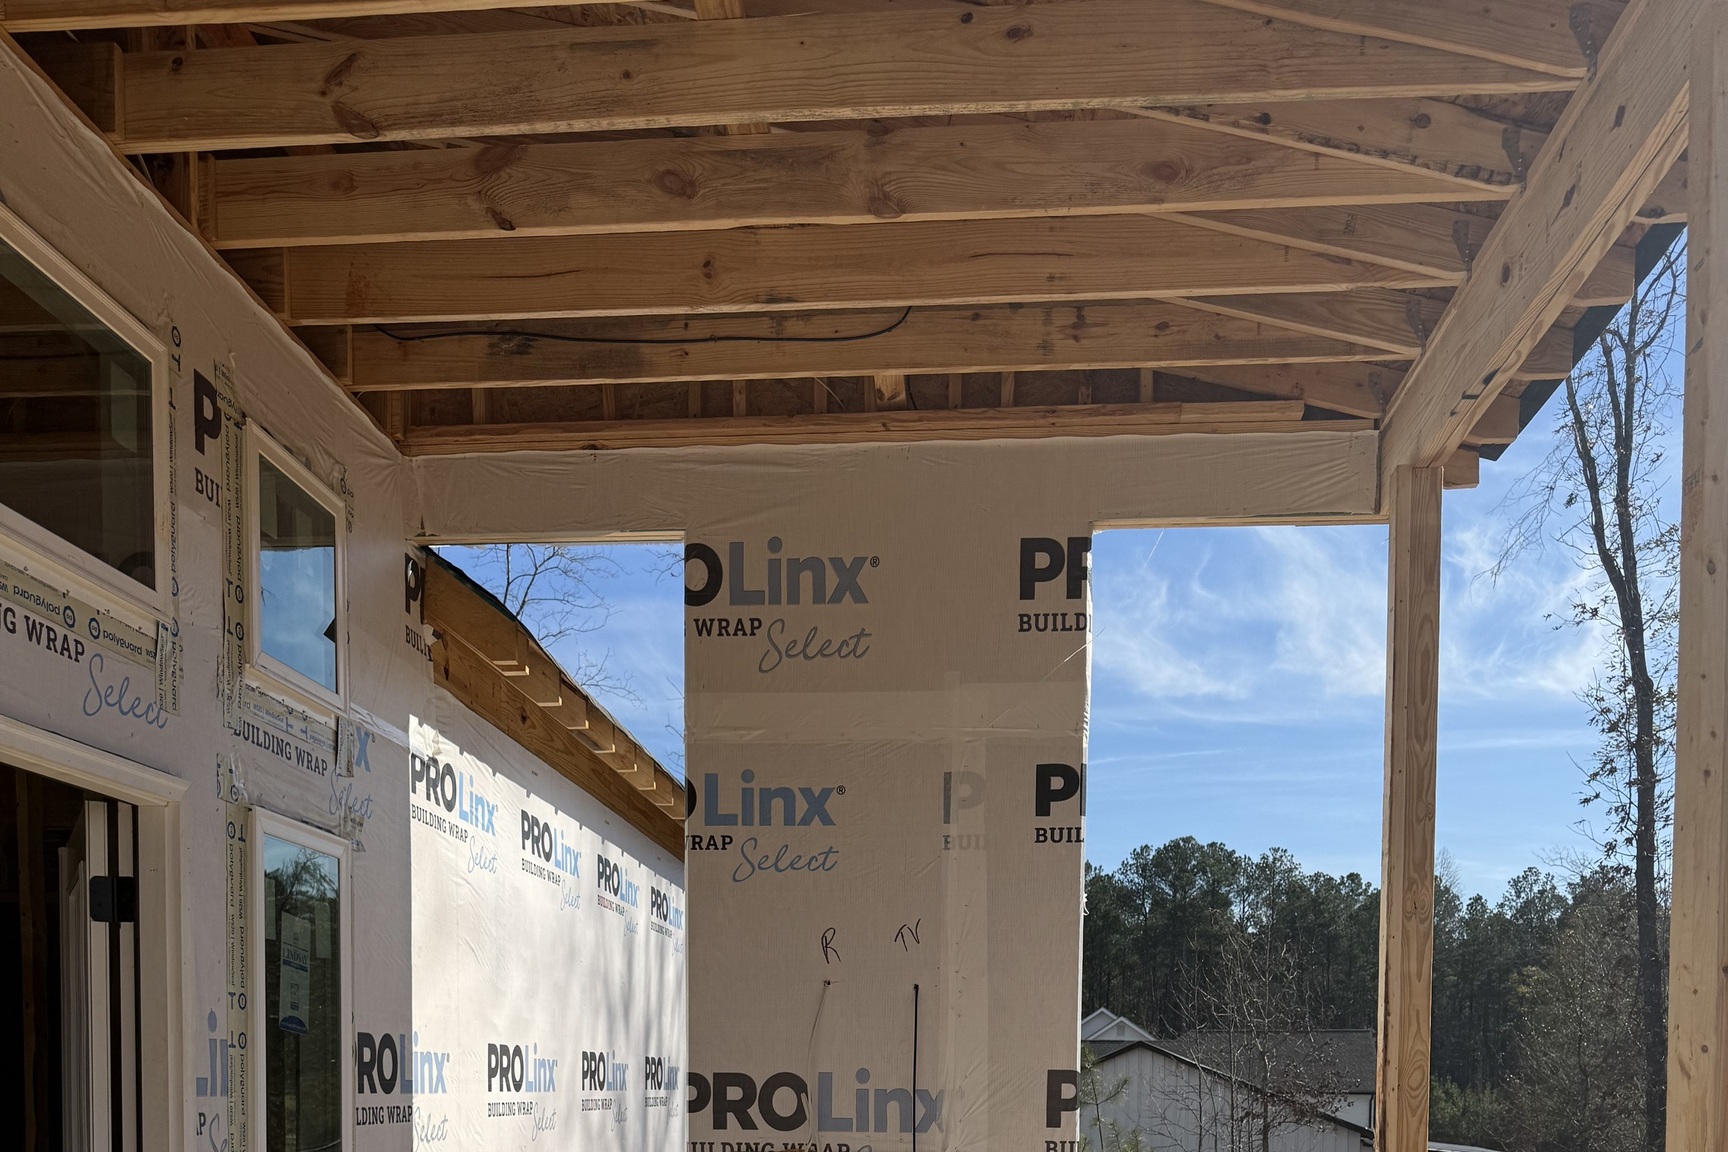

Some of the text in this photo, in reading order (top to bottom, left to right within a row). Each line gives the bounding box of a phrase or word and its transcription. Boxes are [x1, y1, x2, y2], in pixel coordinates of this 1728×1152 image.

[24, 614, 86, 663] WRAP
[103, 630, 143, 655] polyguard
[694, 618, 763, 638] WRAP
[758, 618, 873, 674] Select
[234, 720, 292, 761] UILDING
[295, 746, 328, 777] WRAP
[411, 804, 469, 843] BUILDING WRAP
[468, 835, 498, 874] Select
[685, 835, 734, 851] RAP
[732, 837, 839, 883] Select
[521, 858, 561, 887] BUILDING WRAP
[560, 879, 580, 911] Select
[387, 1105, 413, 1124] WRAP
[488, 1101, 533, 1117] BUILDING WRAP
[532, 1101, 557, 1142] Select
